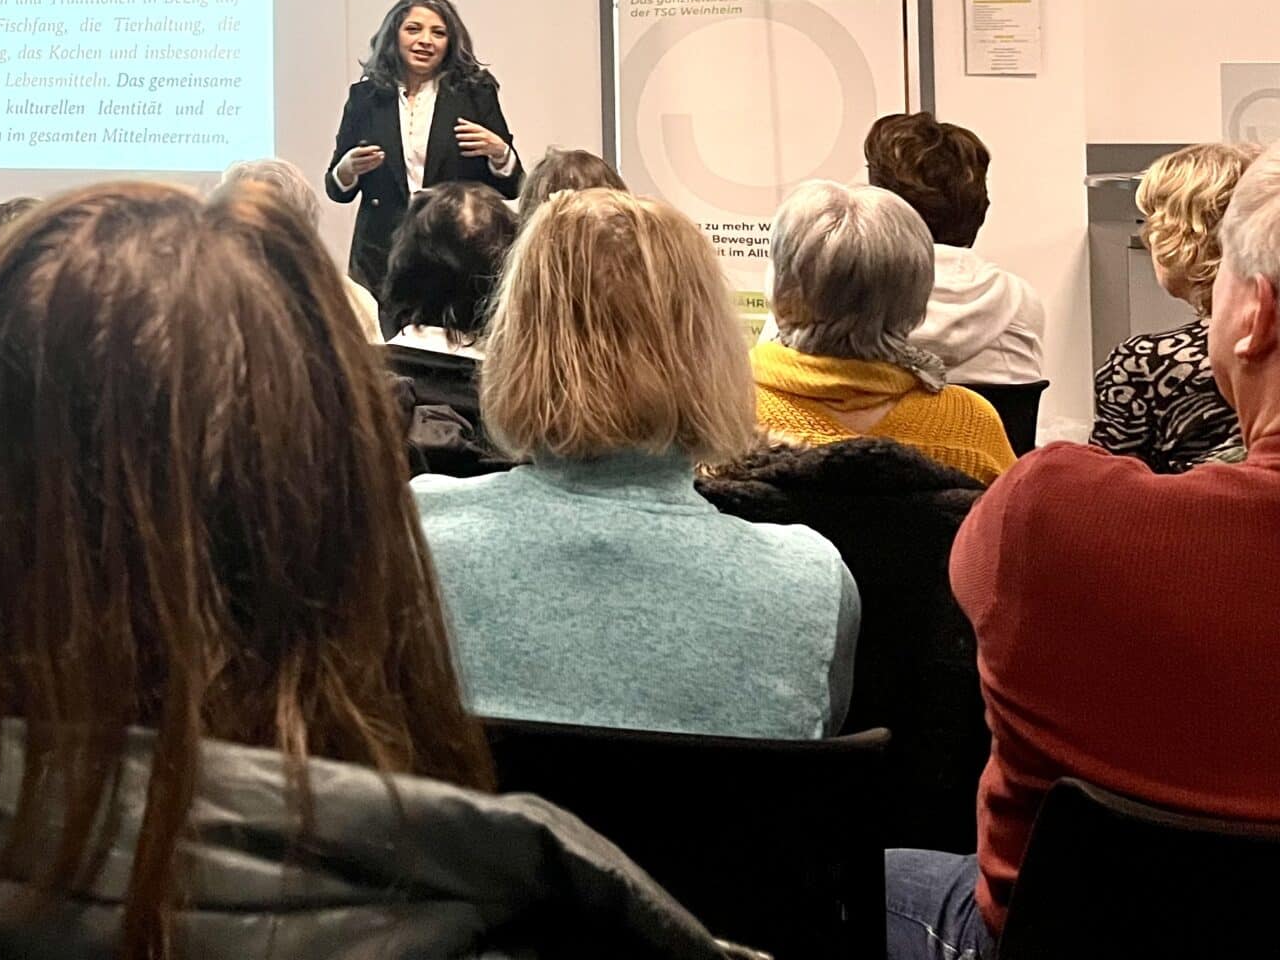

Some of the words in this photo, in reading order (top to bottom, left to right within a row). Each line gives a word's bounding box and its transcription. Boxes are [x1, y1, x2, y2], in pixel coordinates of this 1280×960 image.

[630, 7, 650, 18] der
[654, 6, 677, 17] TSG
[681, 5, 743, 16] Weinheim
[80, 15, 102, 32] die
[113, 15, 206, 37] Tierhaltung,
[218, 14, 240, 31] die
[18, 43, 43, 59] das
[49, 42, 103, 59] Kochen
[110, 43, 138, 59] und
[145, 42, 241, 59] insbesondere
[4, 71, 111, 88] Lebensmitteln.
[116, 71, 145, 88] Das
[147, 73, 242, 93] gemeinsame
[5, 98, 85, 116] kulturellen
[97, 98, 163, 116] Identität
[175, 99, 205, 116] und
[215, 98, 242, 116] der
[6, 126, 26, 143] im
[28, 127, 97, 147] gesamten
[102, 126, 230, 145] Mittelmeerraum.
[705, 223, 719, 231] zu
[722, 222, 755, 231] mehr
[712, 234, 770, 246] Bewegun
[729, 247, 744, 257] im
